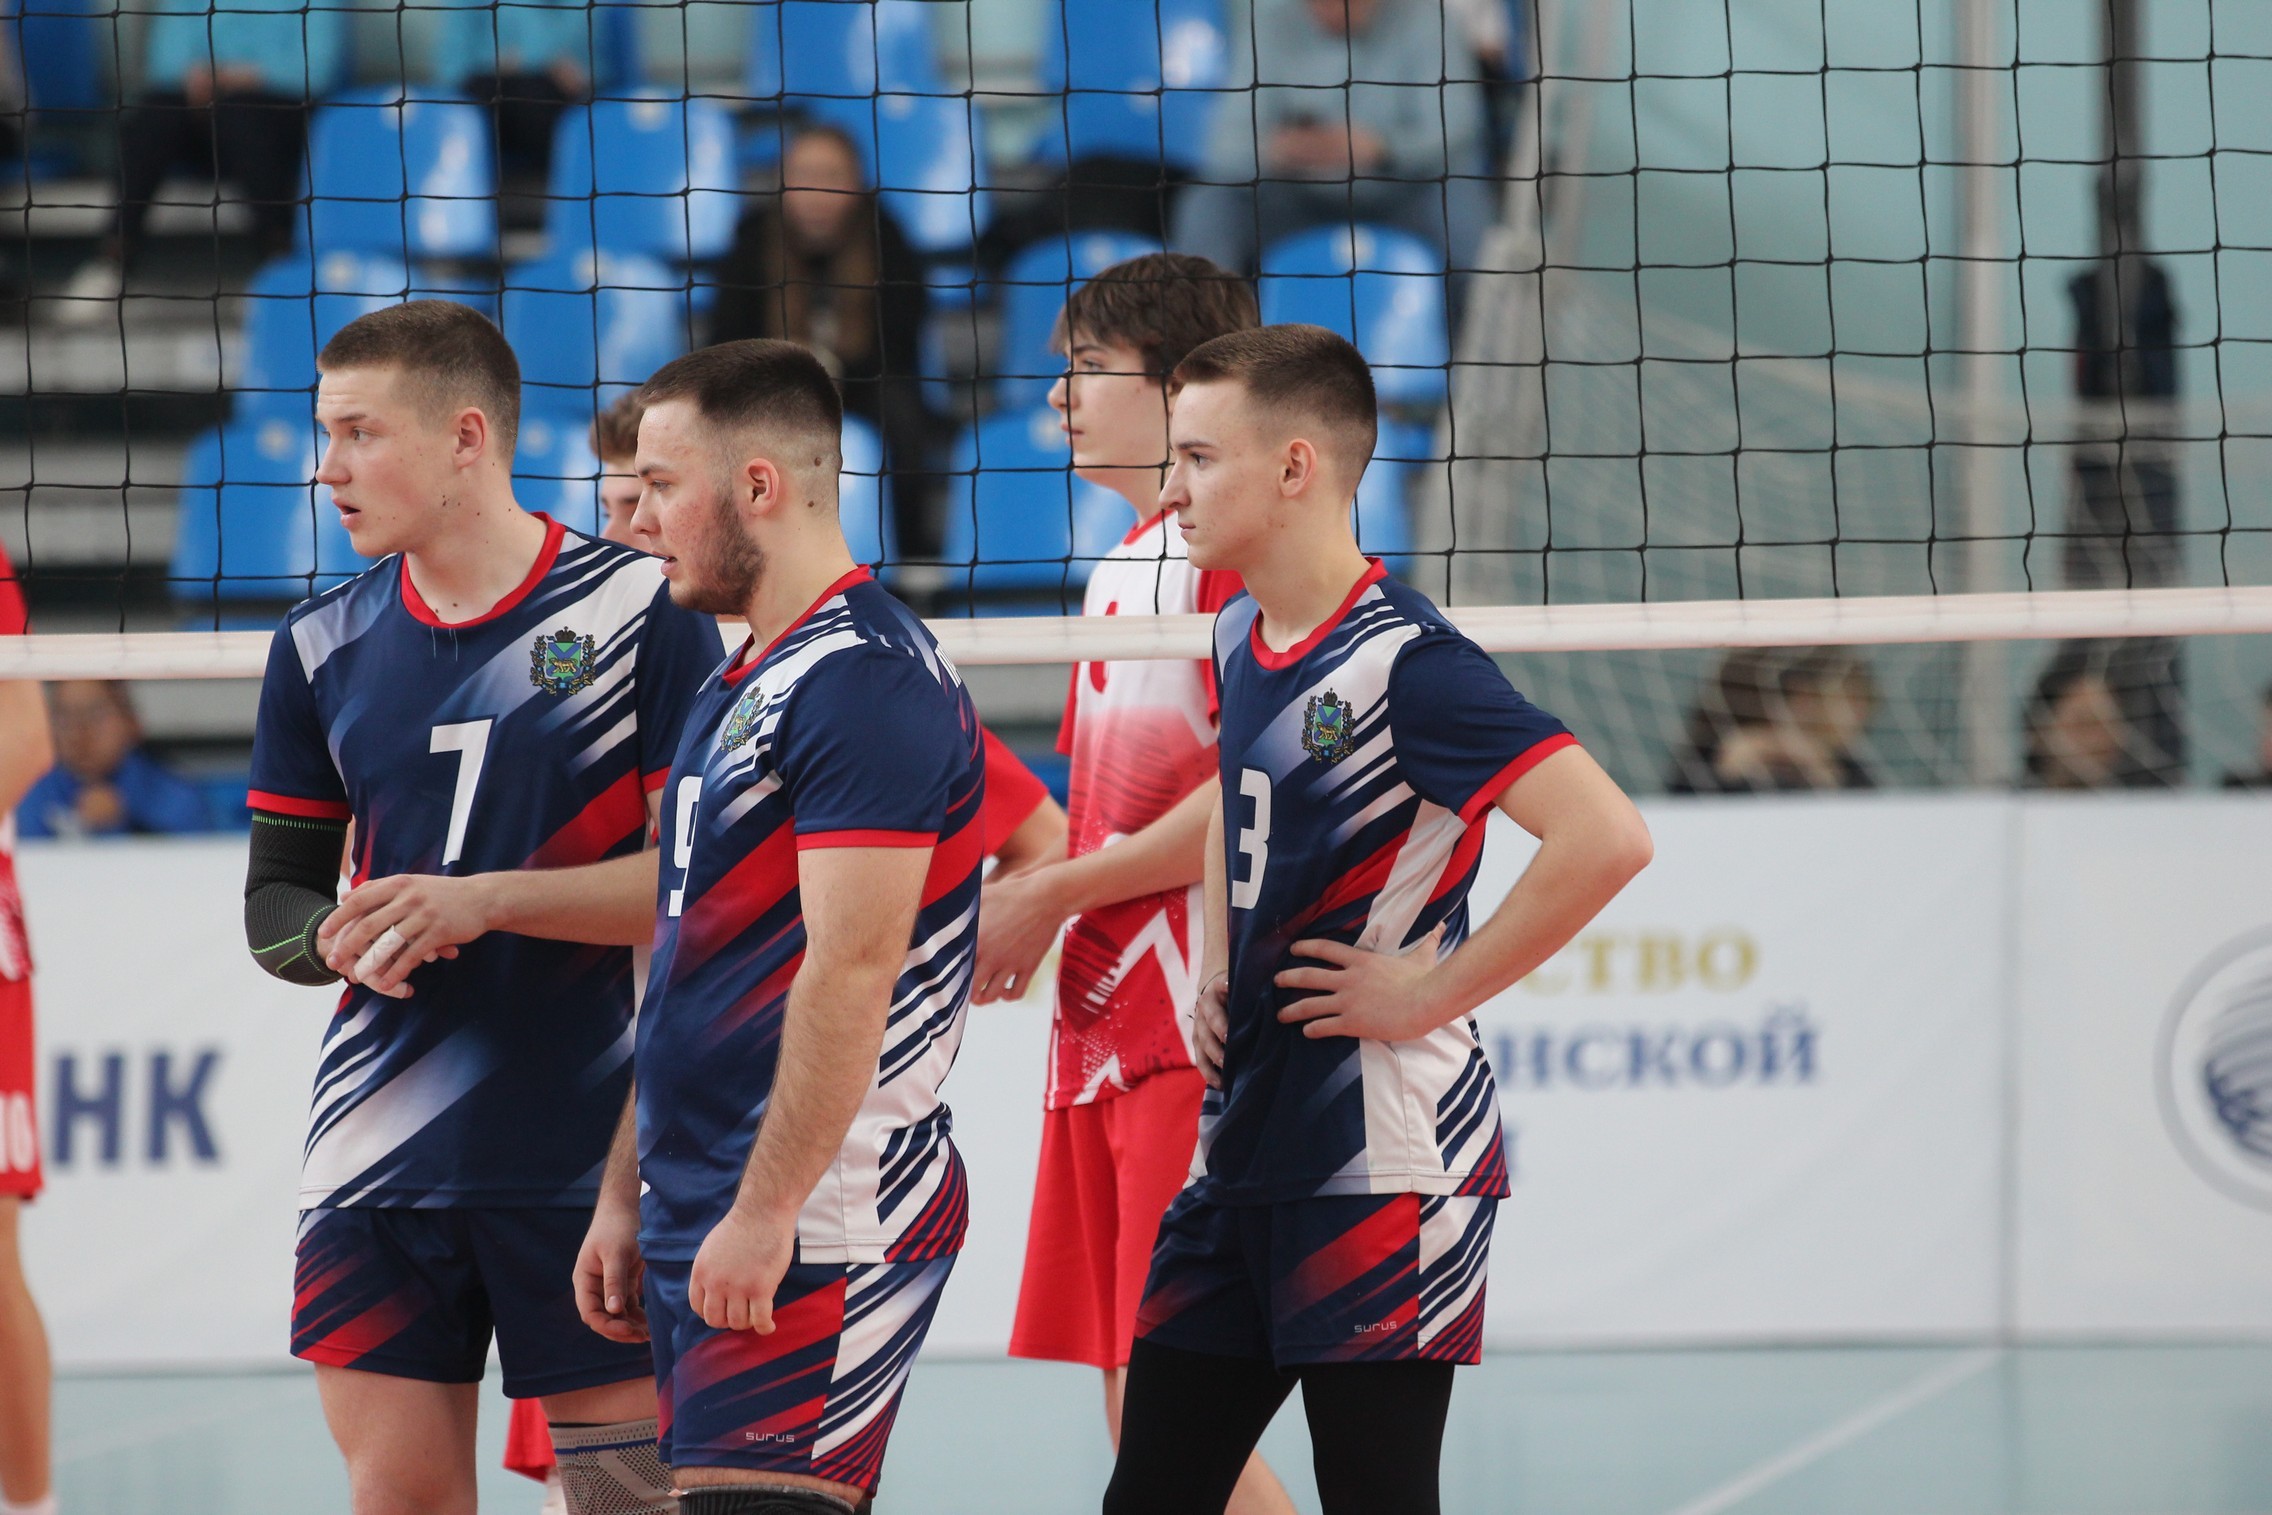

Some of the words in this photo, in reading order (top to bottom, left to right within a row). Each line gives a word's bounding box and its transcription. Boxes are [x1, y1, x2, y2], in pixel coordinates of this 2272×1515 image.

[429, 718, 494, 867] 7
[668, 775, 704, 917] 9
[1231, 767, 1272, 910] 3
